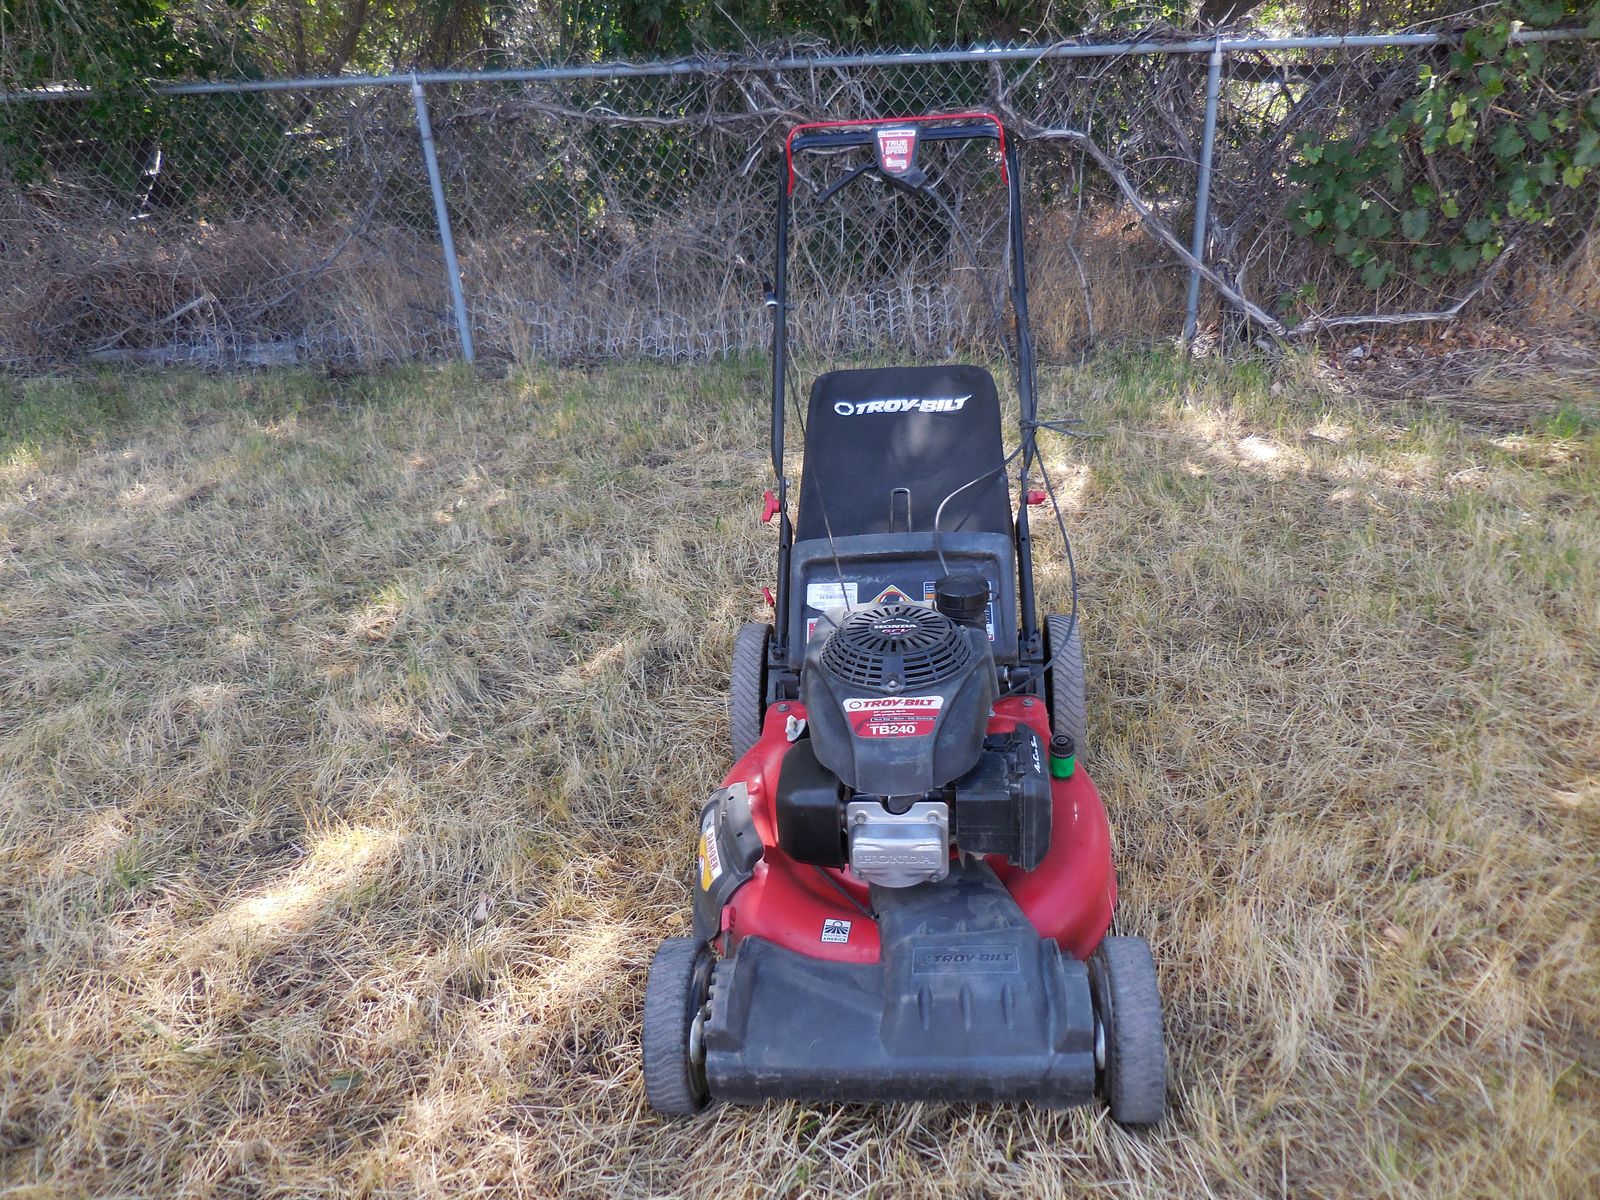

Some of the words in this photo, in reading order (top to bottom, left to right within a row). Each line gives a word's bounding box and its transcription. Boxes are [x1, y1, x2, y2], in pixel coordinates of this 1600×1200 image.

[855, 394, 972, 415] TROY-BILT
[864, 699, 934, 708] TROY-BILT
[869, 725, 916, 735] TB240
[707, 831, 719, 871] DANGER
[859, 855, 936, 864] HONDA
